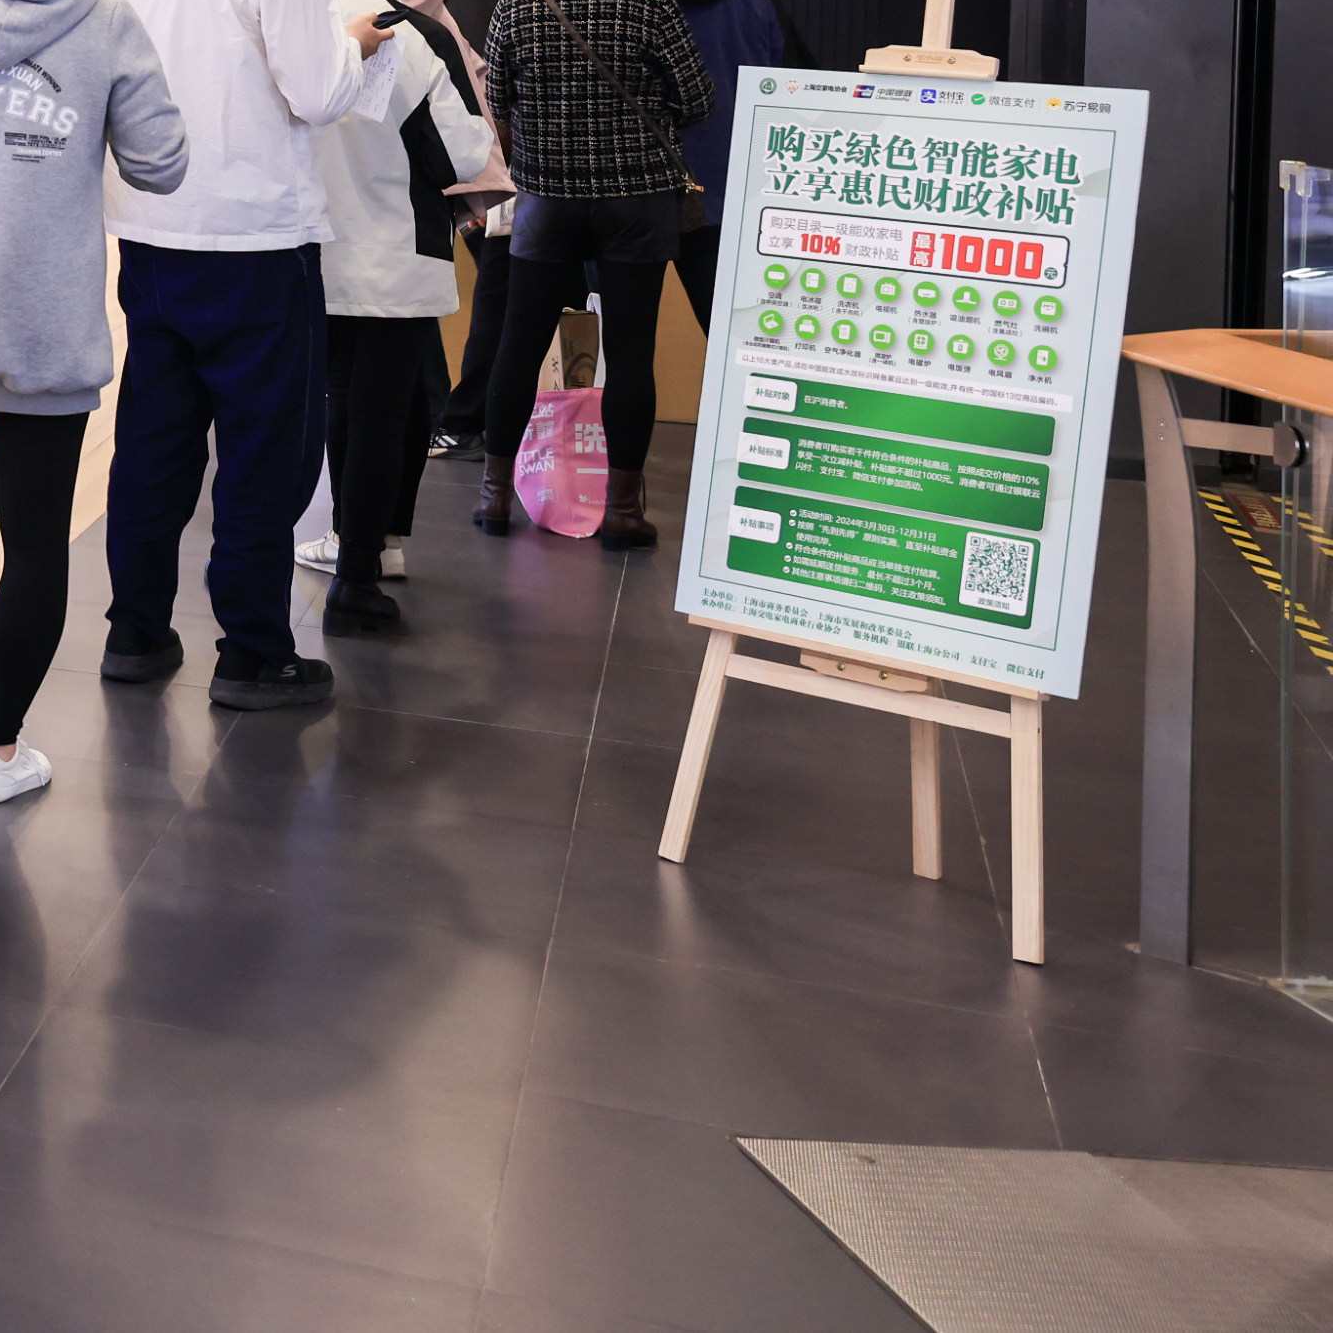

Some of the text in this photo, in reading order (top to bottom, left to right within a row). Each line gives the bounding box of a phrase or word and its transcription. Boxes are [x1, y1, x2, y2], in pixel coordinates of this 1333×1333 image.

[7, 66, 43, 90] XUAN
[939, 91, 964, 101] 支付宝
[989, 96, 1035, 108] 微信支付
[1063, 101, 1111, 114] 苏宁易购
[766, 125, 1081, 185] 购买绿色智能家电
[766, 163, 1076, 225] 立享惠民财政补贴
[770, 216, 903, 242] 购买目录一级能效家电
[769, 233, 899, 261] 立享 10% 财政补贴
[912, 233, 1045, 280] 最高 1000
[1046, 268, 1058, 280] 元
[838, 301, 859, 309] 洗衣机
[875, 305, 898, 314] 电视机
[950, 315, 981, 325] 吸油烟机
[795, 343, 816, 352] 打印机
[756, 387, 790, 401] 补贴对象
[574, 422, 608, 454] 洗
[749, 444, 784, 458] 补贴标准
[519, 458, 555, 478] SWAN
[739, 517, 775, 532] 补贴事项
